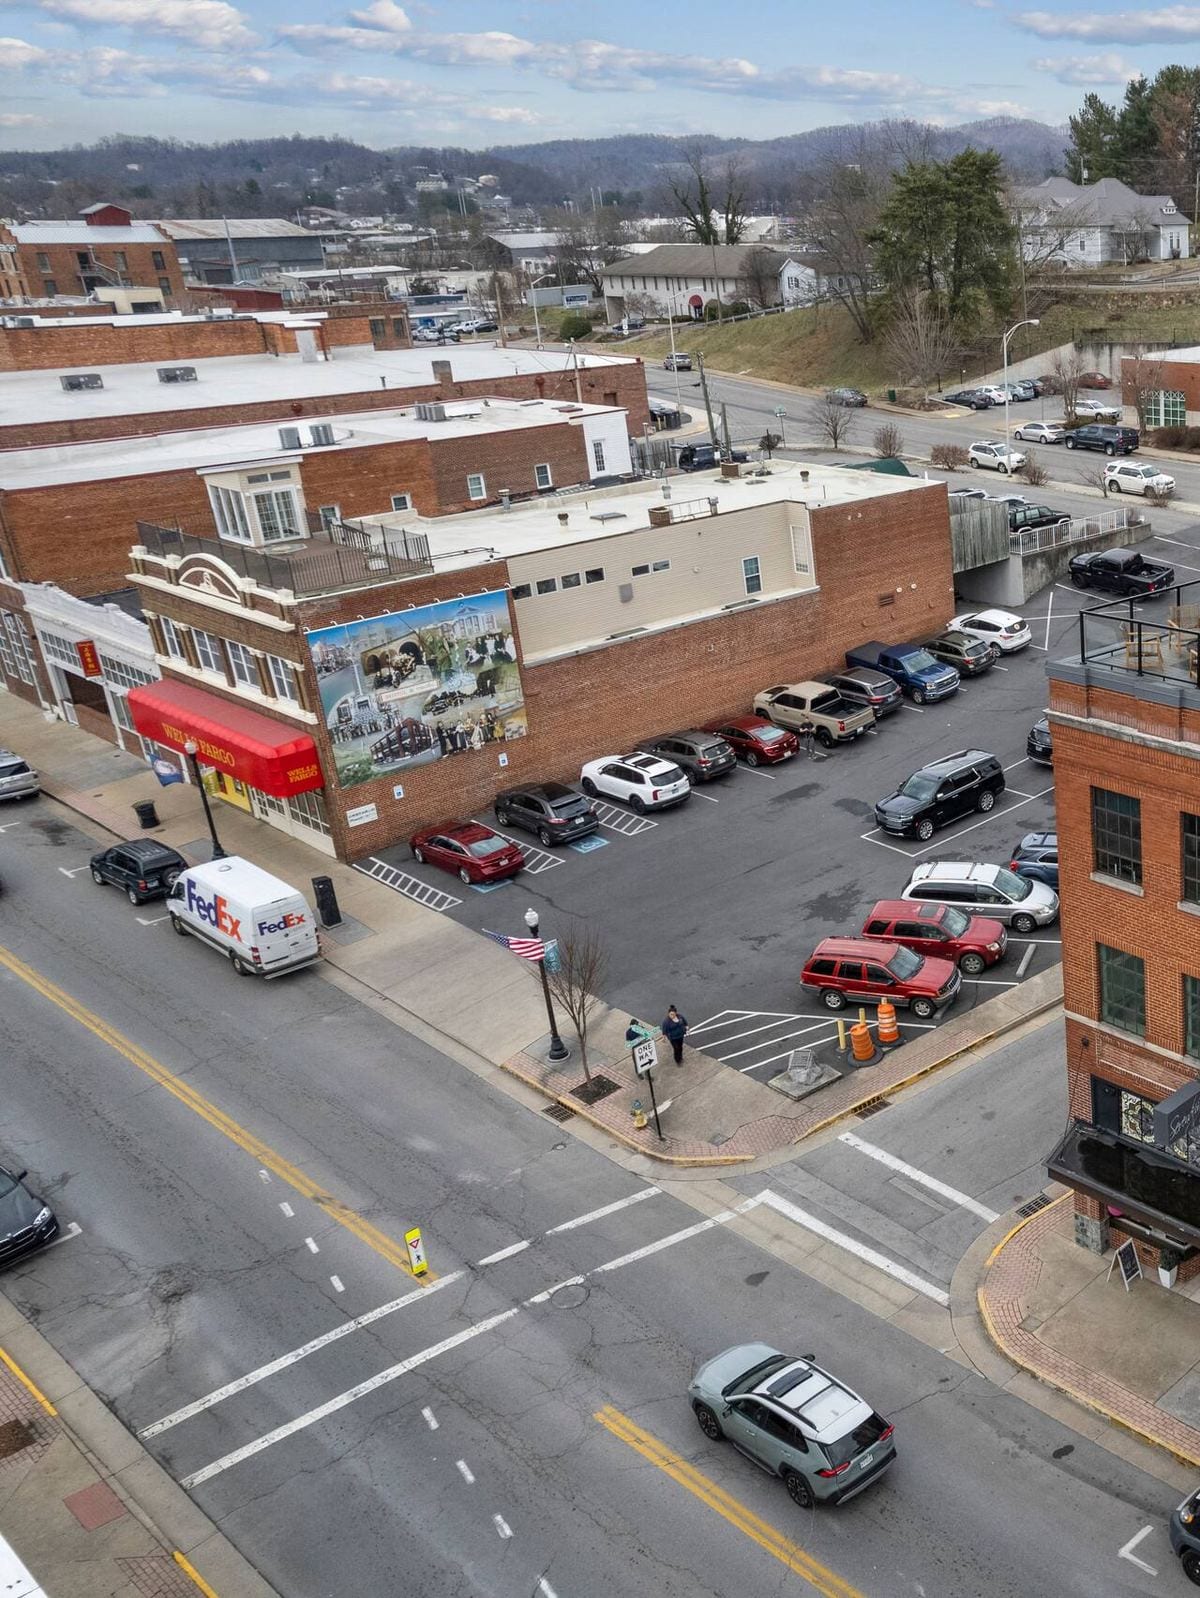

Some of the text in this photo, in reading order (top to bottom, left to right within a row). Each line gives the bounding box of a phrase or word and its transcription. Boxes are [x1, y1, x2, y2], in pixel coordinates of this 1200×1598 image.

[199, 739, 235, 767] FARGO
[186, 878, 242, 943] FedEx
[257, 913, 306, 936] FedEx
[638, 1043, 653, 1054] ONE
[639, 1050, 653, 1061] WAY
